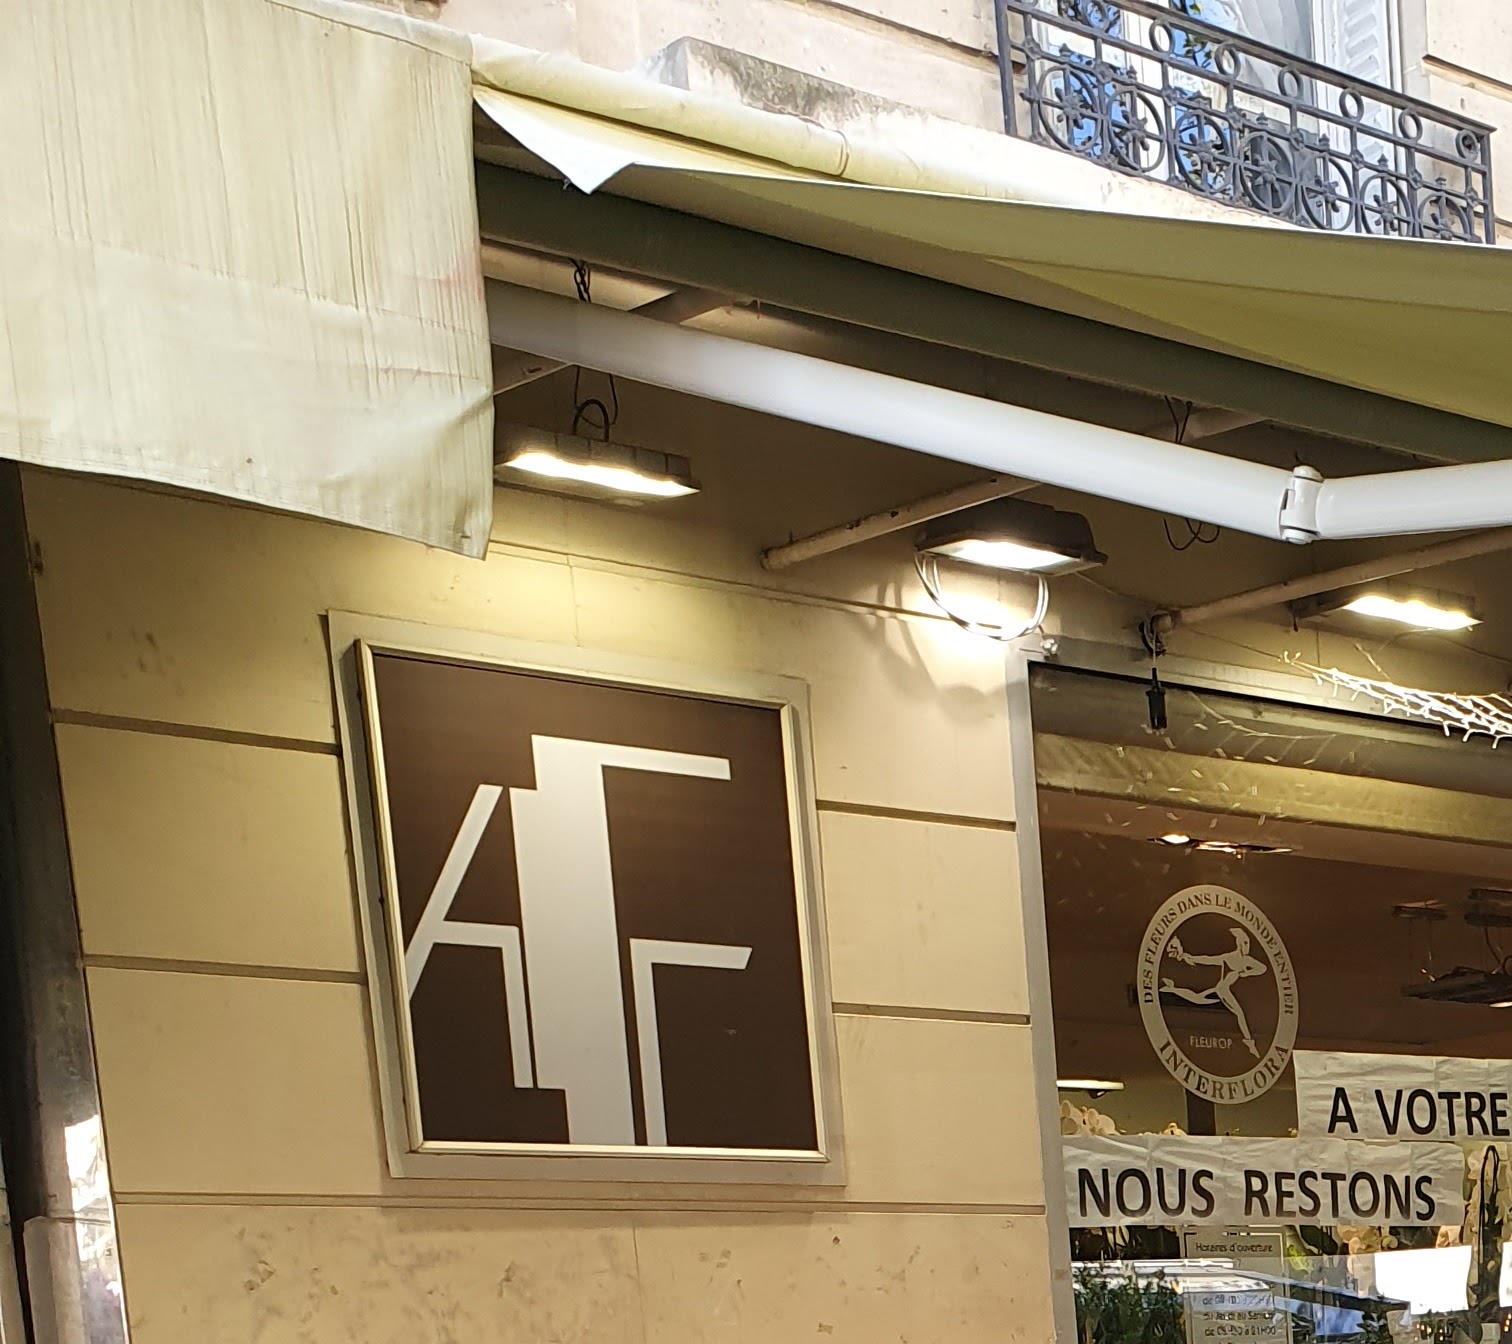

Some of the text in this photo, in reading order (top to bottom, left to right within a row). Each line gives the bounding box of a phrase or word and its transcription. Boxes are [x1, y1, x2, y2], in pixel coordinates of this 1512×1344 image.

[1143, 893, 1295, 1016] DES FLEURS DANS LE MONDE ENTIER
[1159, 1037, 1290, 1101] INTERFLORA
[1189, 1035, 1233, 1050] FLEUROP
[1327, 1086, 1359, 1135] A
[1374, 1088, 1511, 1137] VOTRE
[1077, 1167, 1436, 1222] NOUS RESTONS
